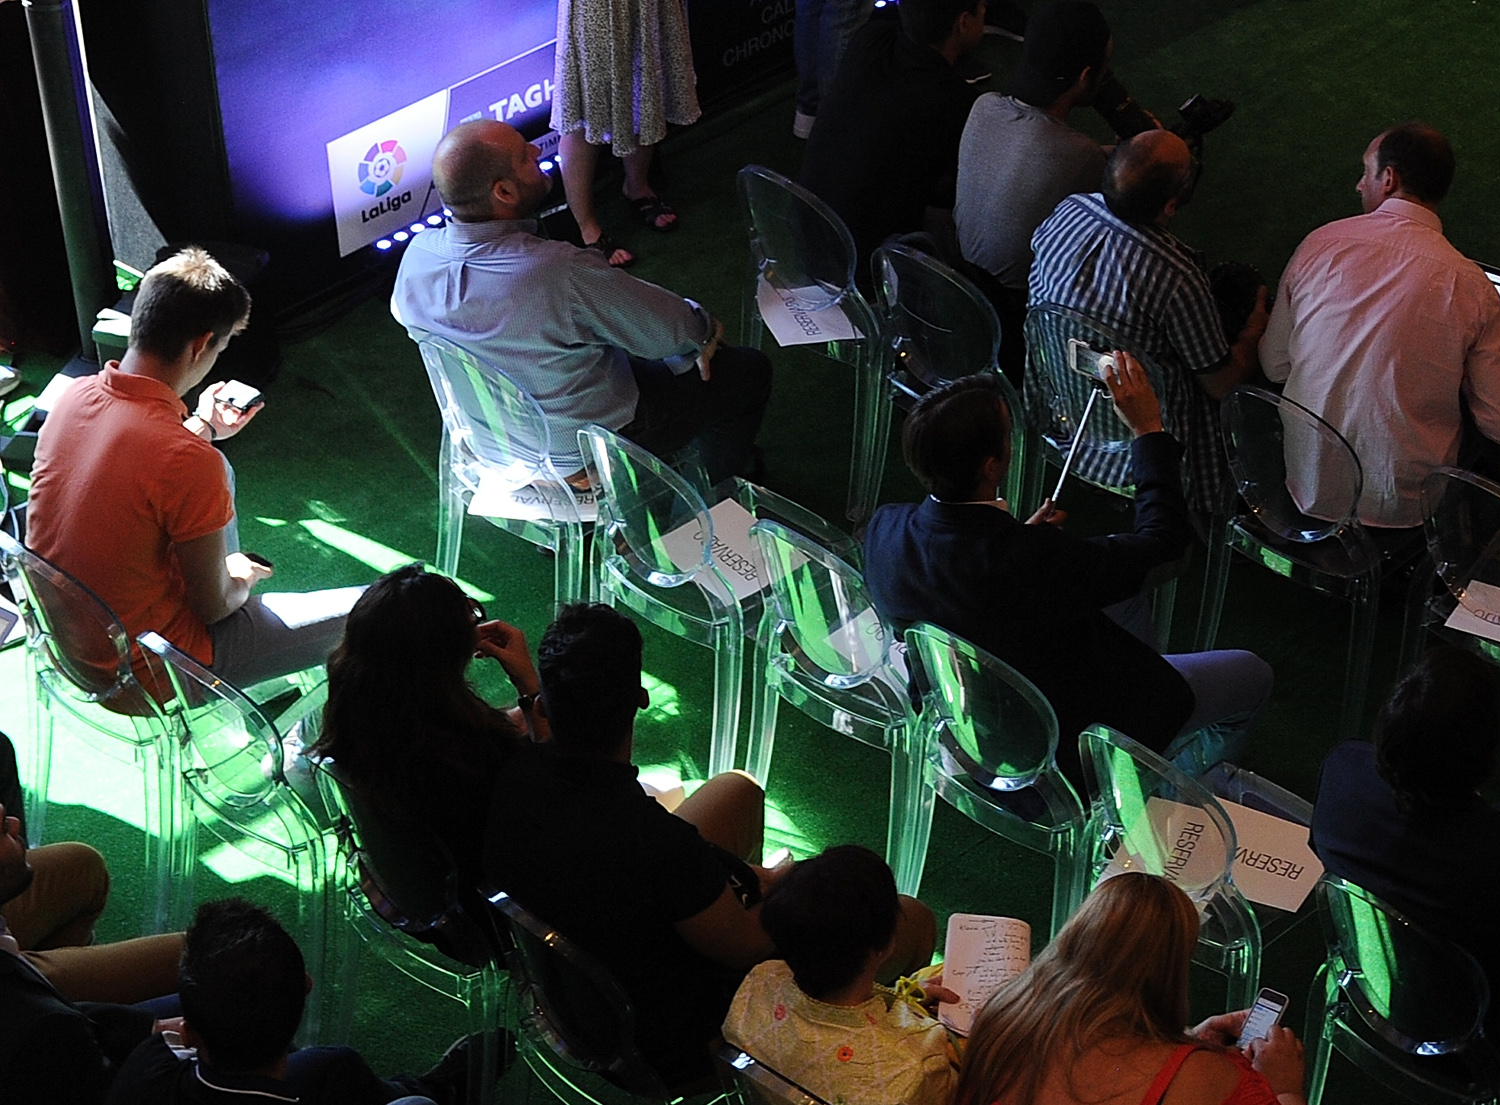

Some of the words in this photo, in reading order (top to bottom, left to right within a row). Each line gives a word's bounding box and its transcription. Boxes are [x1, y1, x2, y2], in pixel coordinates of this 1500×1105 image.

[361, 190, 412, 223] LaLiga
[1163, 821, 1205, 881] RESERVA
[1235, 846, 1305, 881] RESERV
